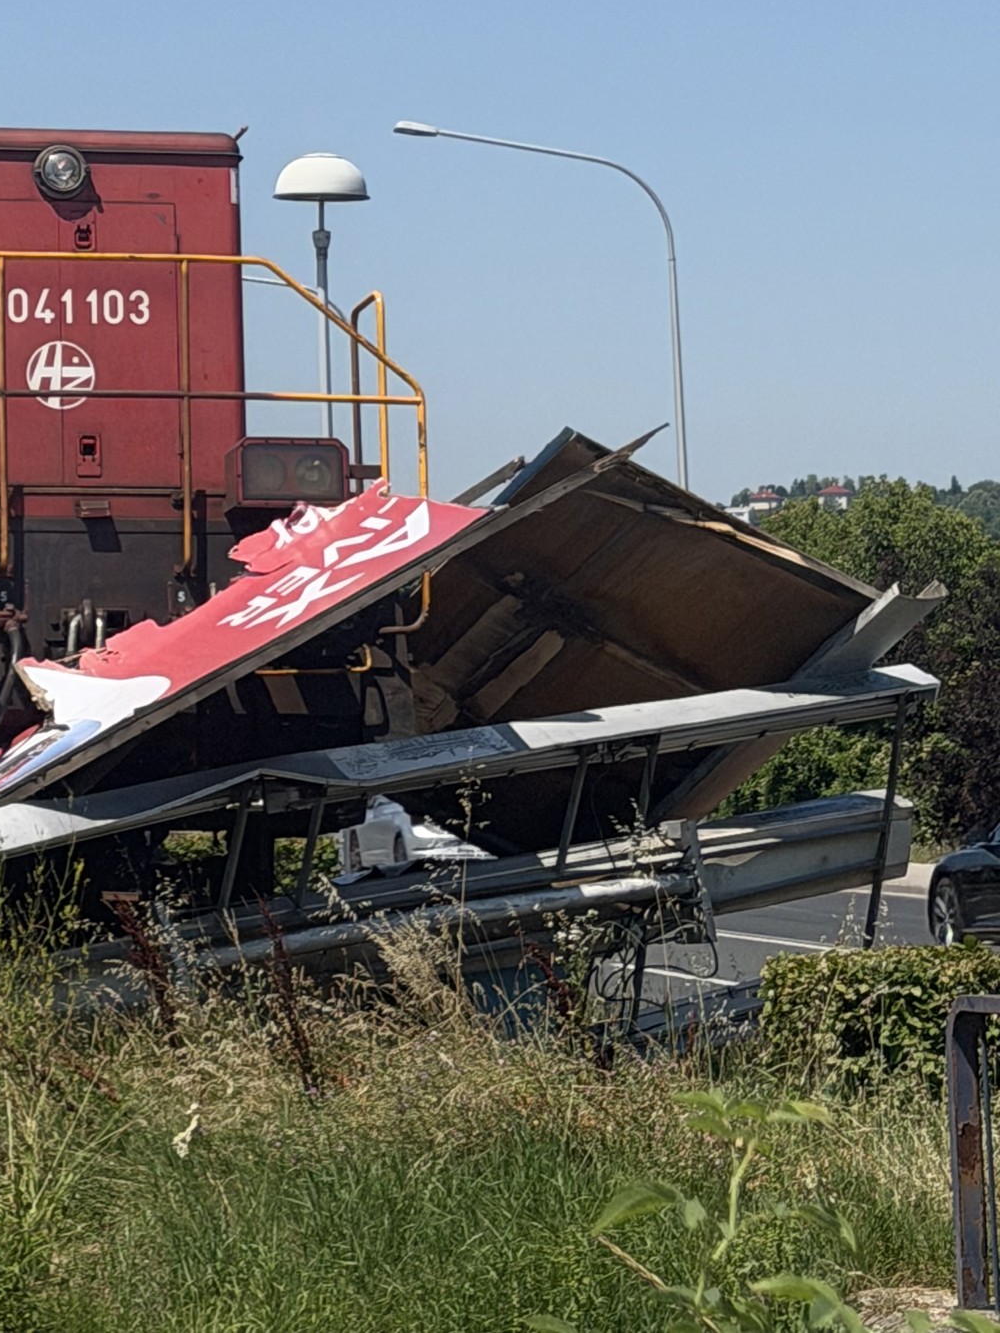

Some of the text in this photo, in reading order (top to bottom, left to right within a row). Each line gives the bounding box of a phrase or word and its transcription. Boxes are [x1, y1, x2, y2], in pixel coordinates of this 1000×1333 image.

[216, 497, 398, 626] IVER
[0, 590, 8, 602] 5
[177, 590, 186, 603] 5
